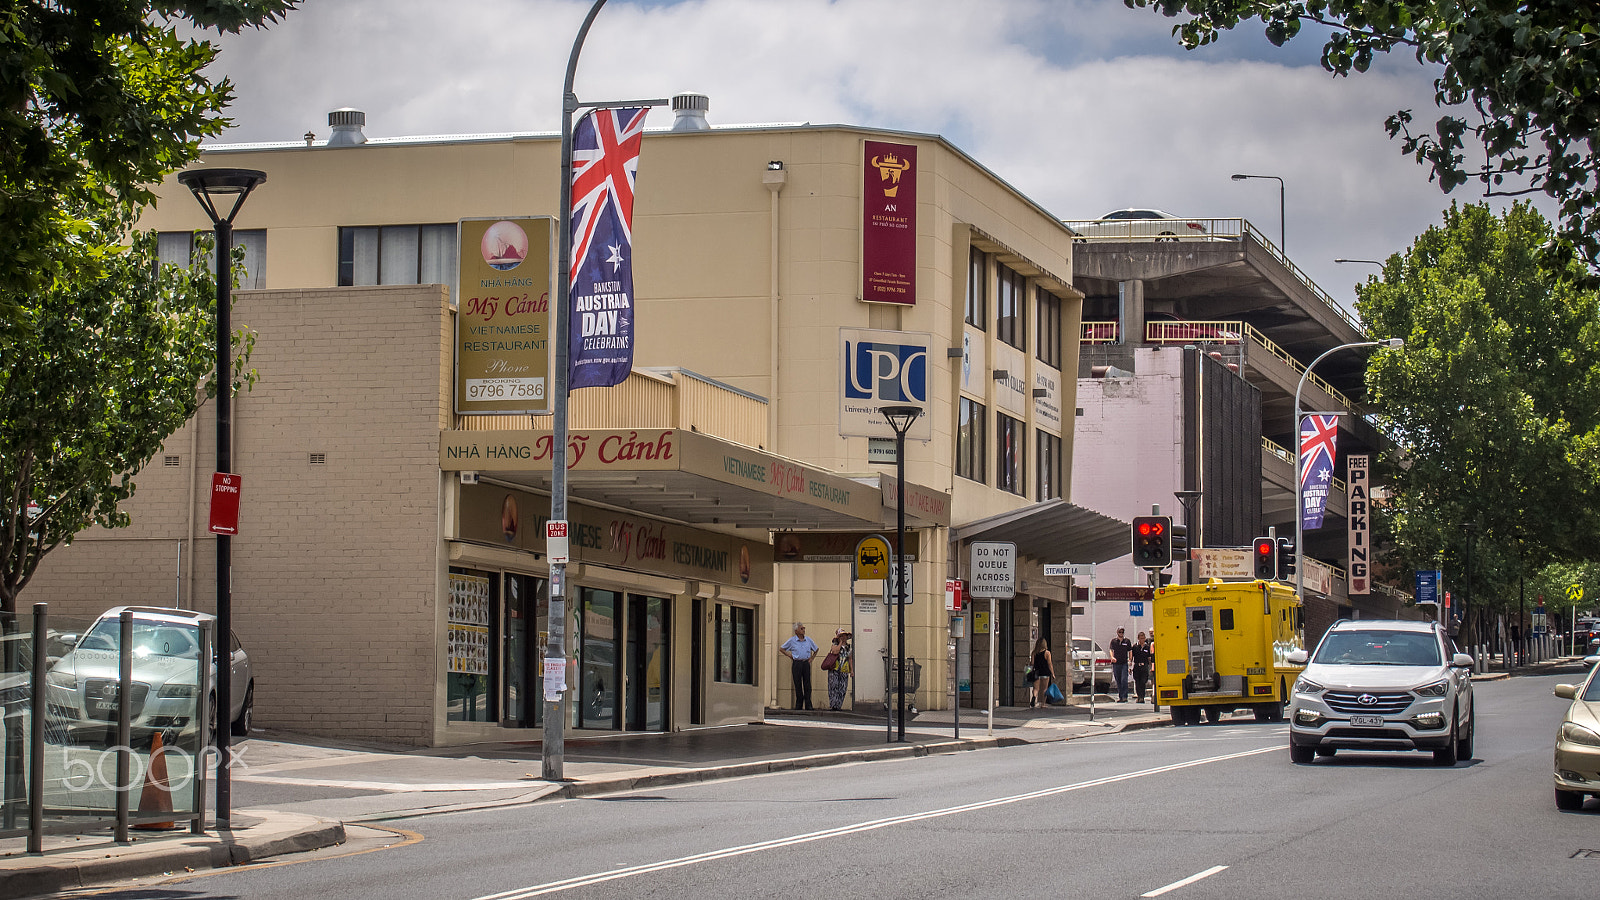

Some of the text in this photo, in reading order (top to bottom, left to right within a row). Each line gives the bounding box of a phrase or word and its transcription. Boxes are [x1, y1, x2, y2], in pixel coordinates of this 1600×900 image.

[884, 204, 897, 212] AN
[872, 215, 908, 223] RESTAURANT
[466, 292, 549, 322] Mỹ Cảnh
[582, 310, 618, 337] DAY
[469, 324, 541, 335] VIETNAMESE
[464, 340, 548, 352] RESTAURANT
[485, 359, 530, 374] Phone
[470, 383, 543, 398] 9796 7586
[845, 405, 872, 415] University
[598, 431, 673, 464] Cảnh
[1349, 457, 1367, 469] FREE
[222, 477, 231, 485] NO
[723, 455, 766, 483] VIETNAMESE
[808, 480, 851, 505] RESTAURANT
[215, 484, 238, 494] STOPPING
[1305, 496, 1322, 509] DAY
[1350, 470, 1367, 578] PARKING
[533, 513, 602, 550] VIAMESE
[635, 521, 667, 561] Cảnh
[672, 541, 729, 573] RESTAURANT
[977, 548, 1010, 557] DO NOT
[978, 560, 1008, 569] QUEUE
[1045, 567, 1079, 575] STEWART LA
[976, 573, 1010, 582] ACROSS
[971, 585, 1014, 593] INTERSECTION
